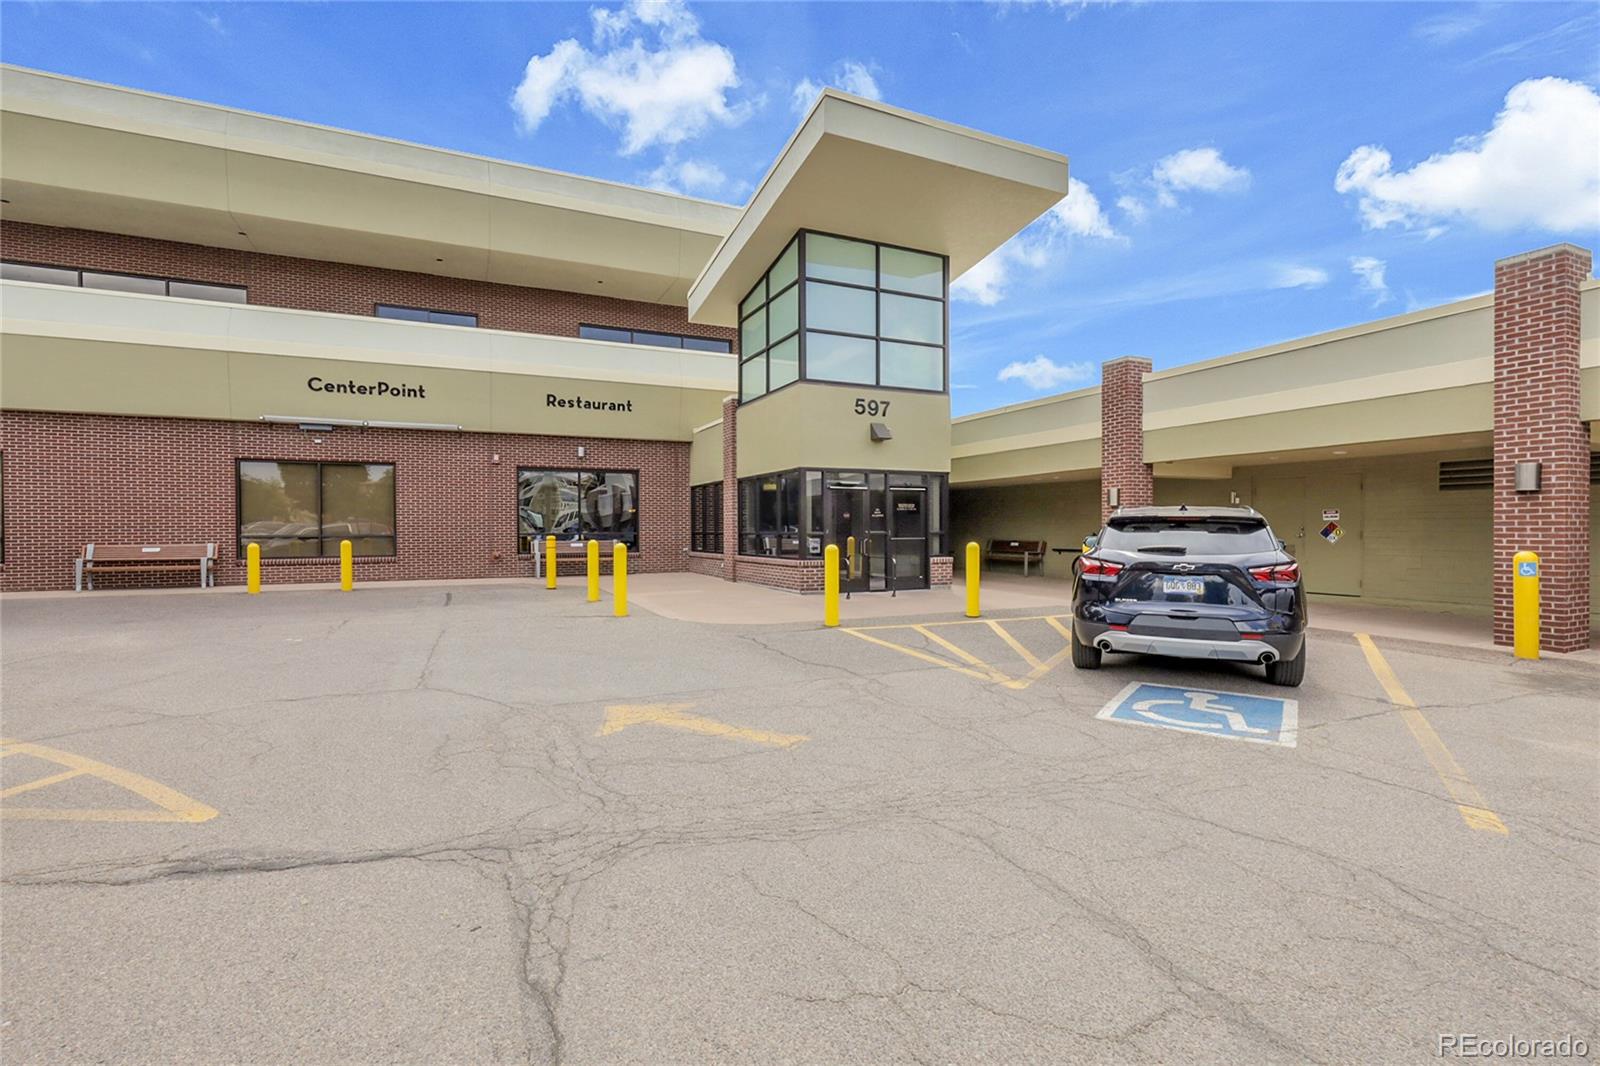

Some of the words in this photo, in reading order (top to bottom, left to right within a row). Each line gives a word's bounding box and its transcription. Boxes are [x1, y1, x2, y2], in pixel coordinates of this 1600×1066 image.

[307, 376, 426, 399] CenterPoint
[546, 393, 633, 412] Restaurant
[854, 398, 891, 417] 597
